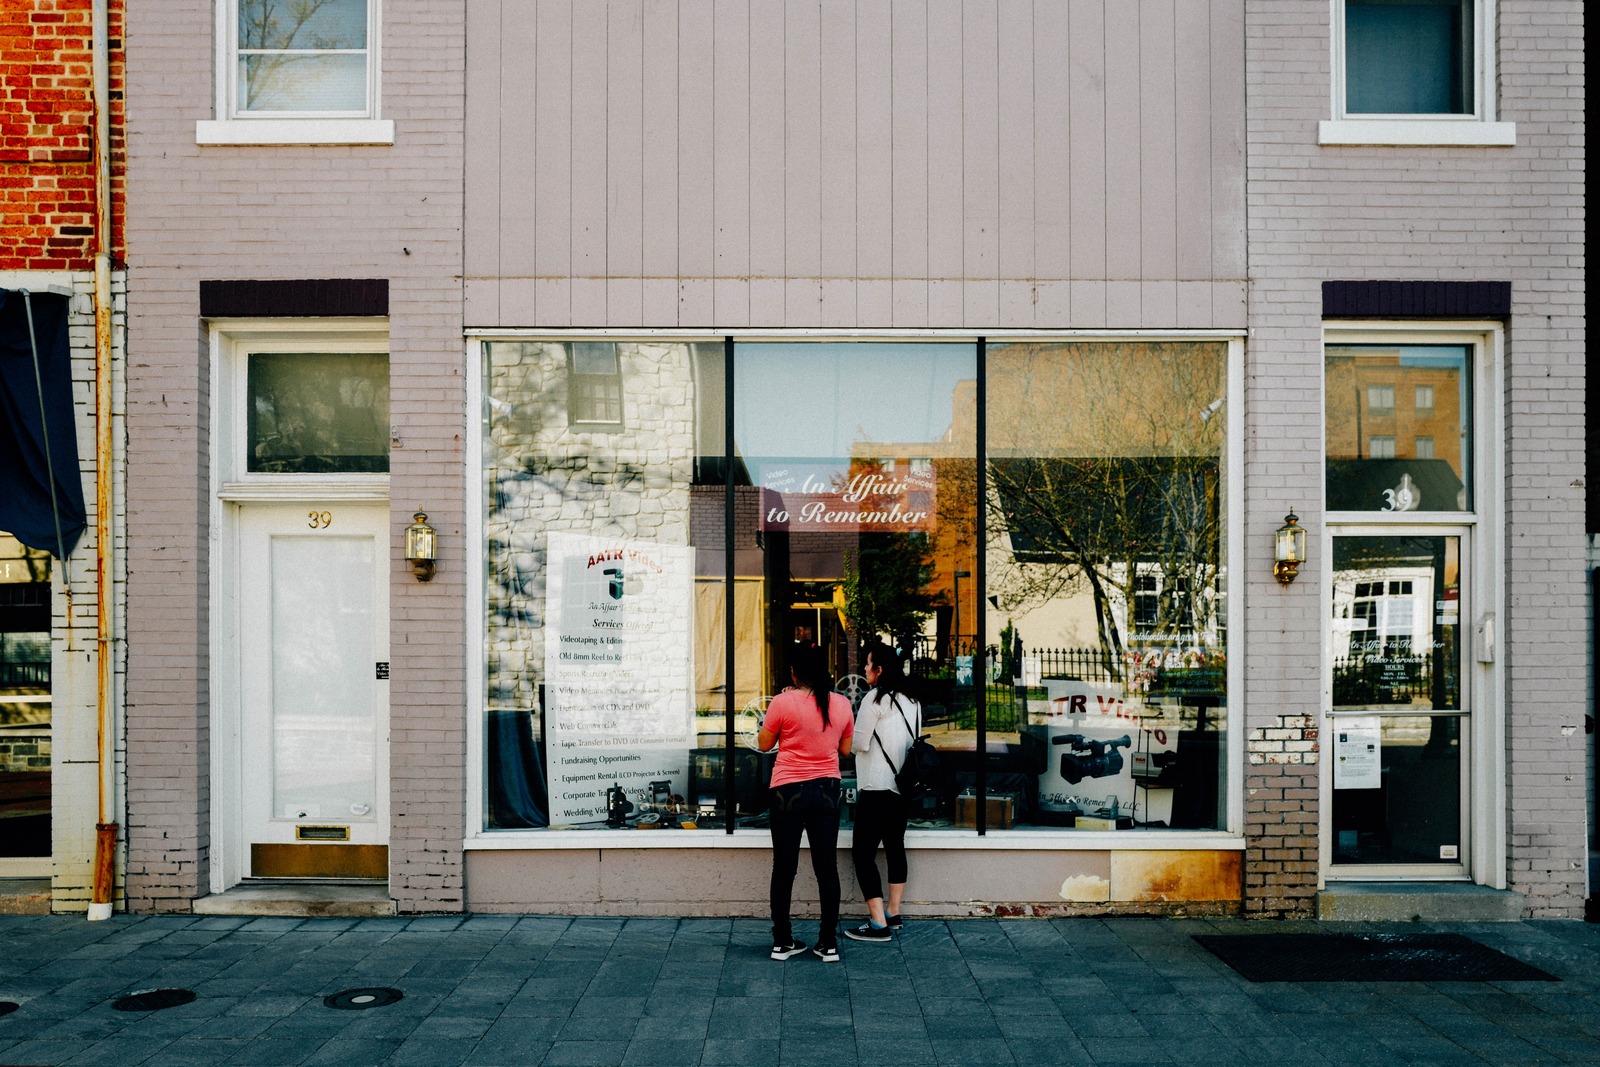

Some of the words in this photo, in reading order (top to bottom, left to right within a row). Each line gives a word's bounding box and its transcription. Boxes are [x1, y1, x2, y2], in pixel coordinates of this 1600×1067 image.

[766, 469, 789, 480] Video
[910, 468, 932, 479] Video
[764, 476, 796, 490] Services
[903, 475, 934, 489] Services
[785, 473, 828, 494] An
[831, 473, 910, 503] Affair
[1381, 488, 1413, 512] 39
[766, 507, 790, 523] to
[799, 501, 928, 524] Remember
[308, 510, 332, 530] 39
[587, 549, 624, 569] AATR
[627, 549, 663, 574] Video
[588, 602, 598, 610] An
[599, 602, 618, 613] Affair
[592, 618, 624, 629] Services
[559, 635, 598, 646] Videotaping
[600, 636, 604, 644] &
[606, 636, 625, 645] Editin
[1399, 639, 1446, 649] Reber
[559, 652, 572, 661] Old
[573, 652, 590, 661] 8mm
[591, 652, 606, 661] Reel
[606, 653, 614, 661] to
[559, 686, 580, 695] Video
[621, 702, 634, 711] and
[559, 722, 576, 730] Web
[577, 721, 617, 730] Commercials
[1047, 694, 1087, 718] TR
[1096, 694, 1168, 746] Vio
[561, 740, 577, 749] Tape
[578, 738, 603, 747] Transfer
[604, 738, 612, 746] to
[612, 737, 629, 746] DVD
[640, 737, 665, 745] Consumer
[561, 755, 598, 766] Fundraising
[598, 753, 642, 765] Opportunities
[561, 772, 597, 784] Equipment
[597, 771, 618, 781] Rental
[632, 770, 656, 779] Projector
[656, 769, 661, 777] &
[662, 768, 681, 776] Screen)
[562, 790, 596, 801] Corporate
[623, 786, 645, 796] Videos
[1122, 801, 1141, 812] LLC
[563, 808, 594, 819] Wedding
